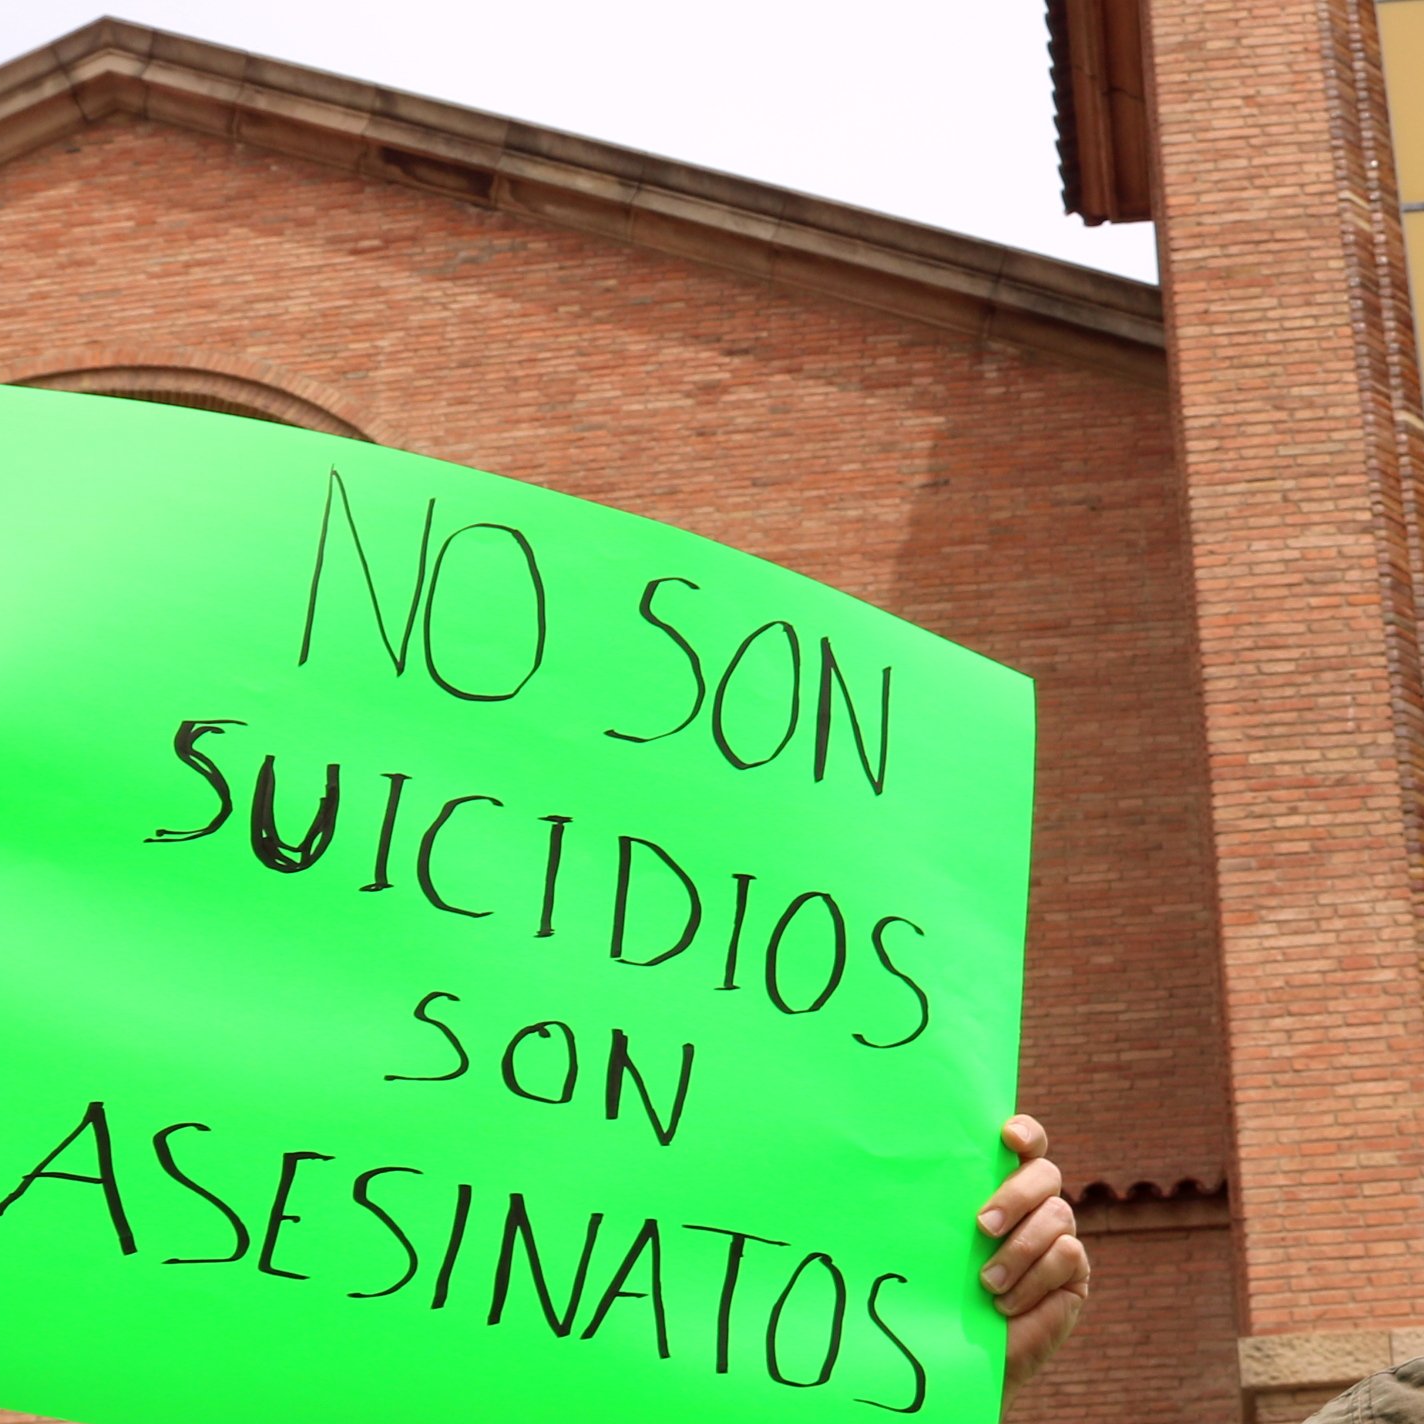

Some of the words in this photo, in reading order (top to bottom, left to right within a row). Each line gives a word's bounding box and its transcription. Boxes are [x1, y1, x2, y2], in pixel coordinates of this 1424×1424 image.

[299, 464, 547, 702] NO
[604, 576, 892, 796] SON
[143, 719, 929, 1048] SUICIDIOS
[384, 991, 695, 1146] SON
